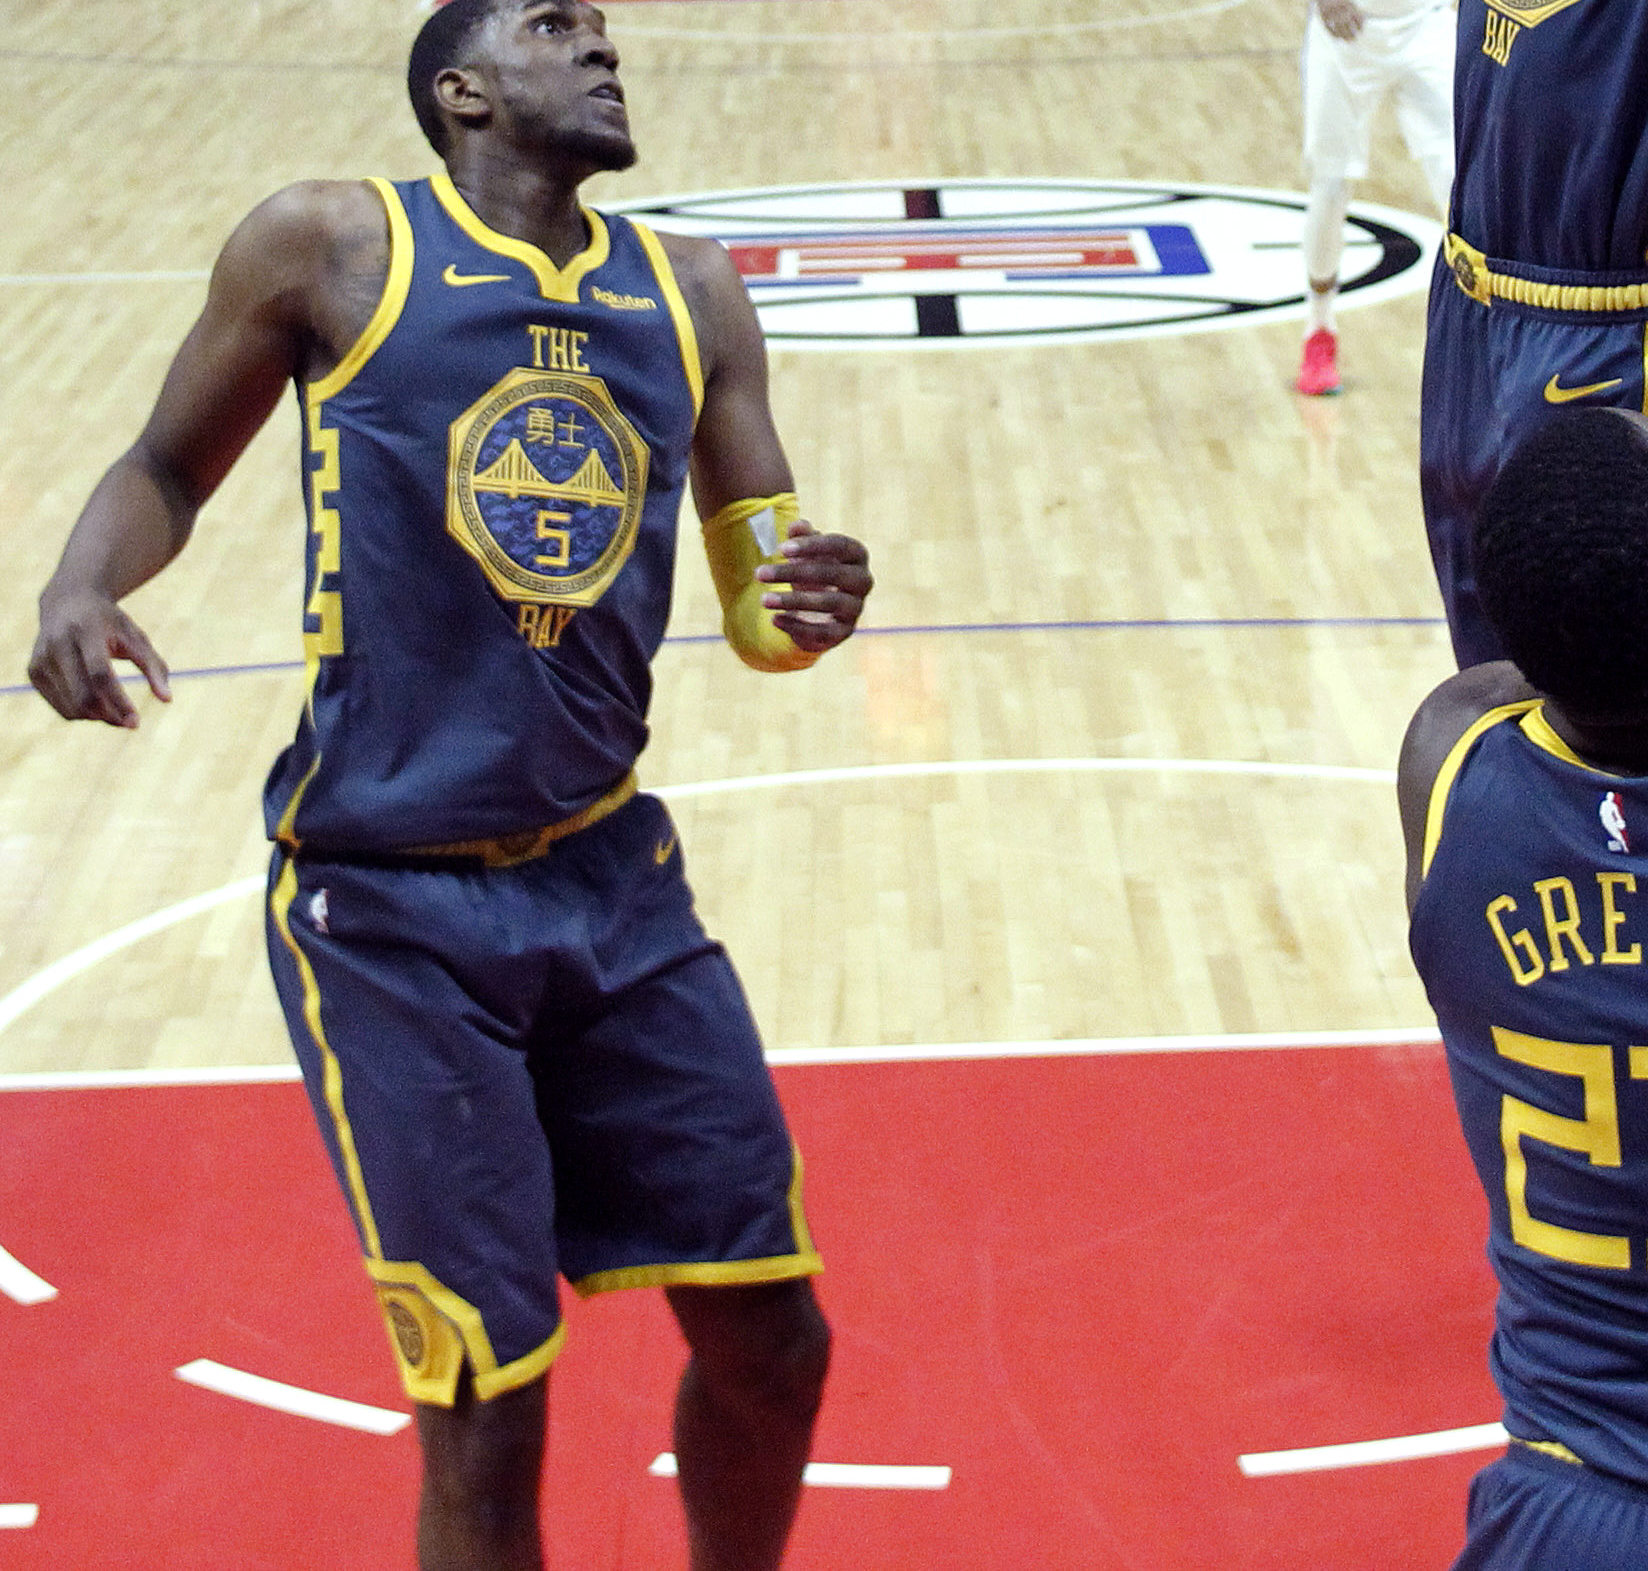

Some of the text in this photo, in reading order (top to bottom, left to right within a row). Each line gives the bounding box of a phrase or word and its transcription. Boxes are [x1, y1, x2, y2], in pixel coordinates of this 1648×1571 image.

[1482, 9, 1521, 67] BAY
[590, 285, 657, 310] Rakuten
[527, 324, 591, 373] THE
[525, 406, 585, 449] 勇士
[536, 509, 571, 567] 5
[518, 603, 578, 649] BAY
